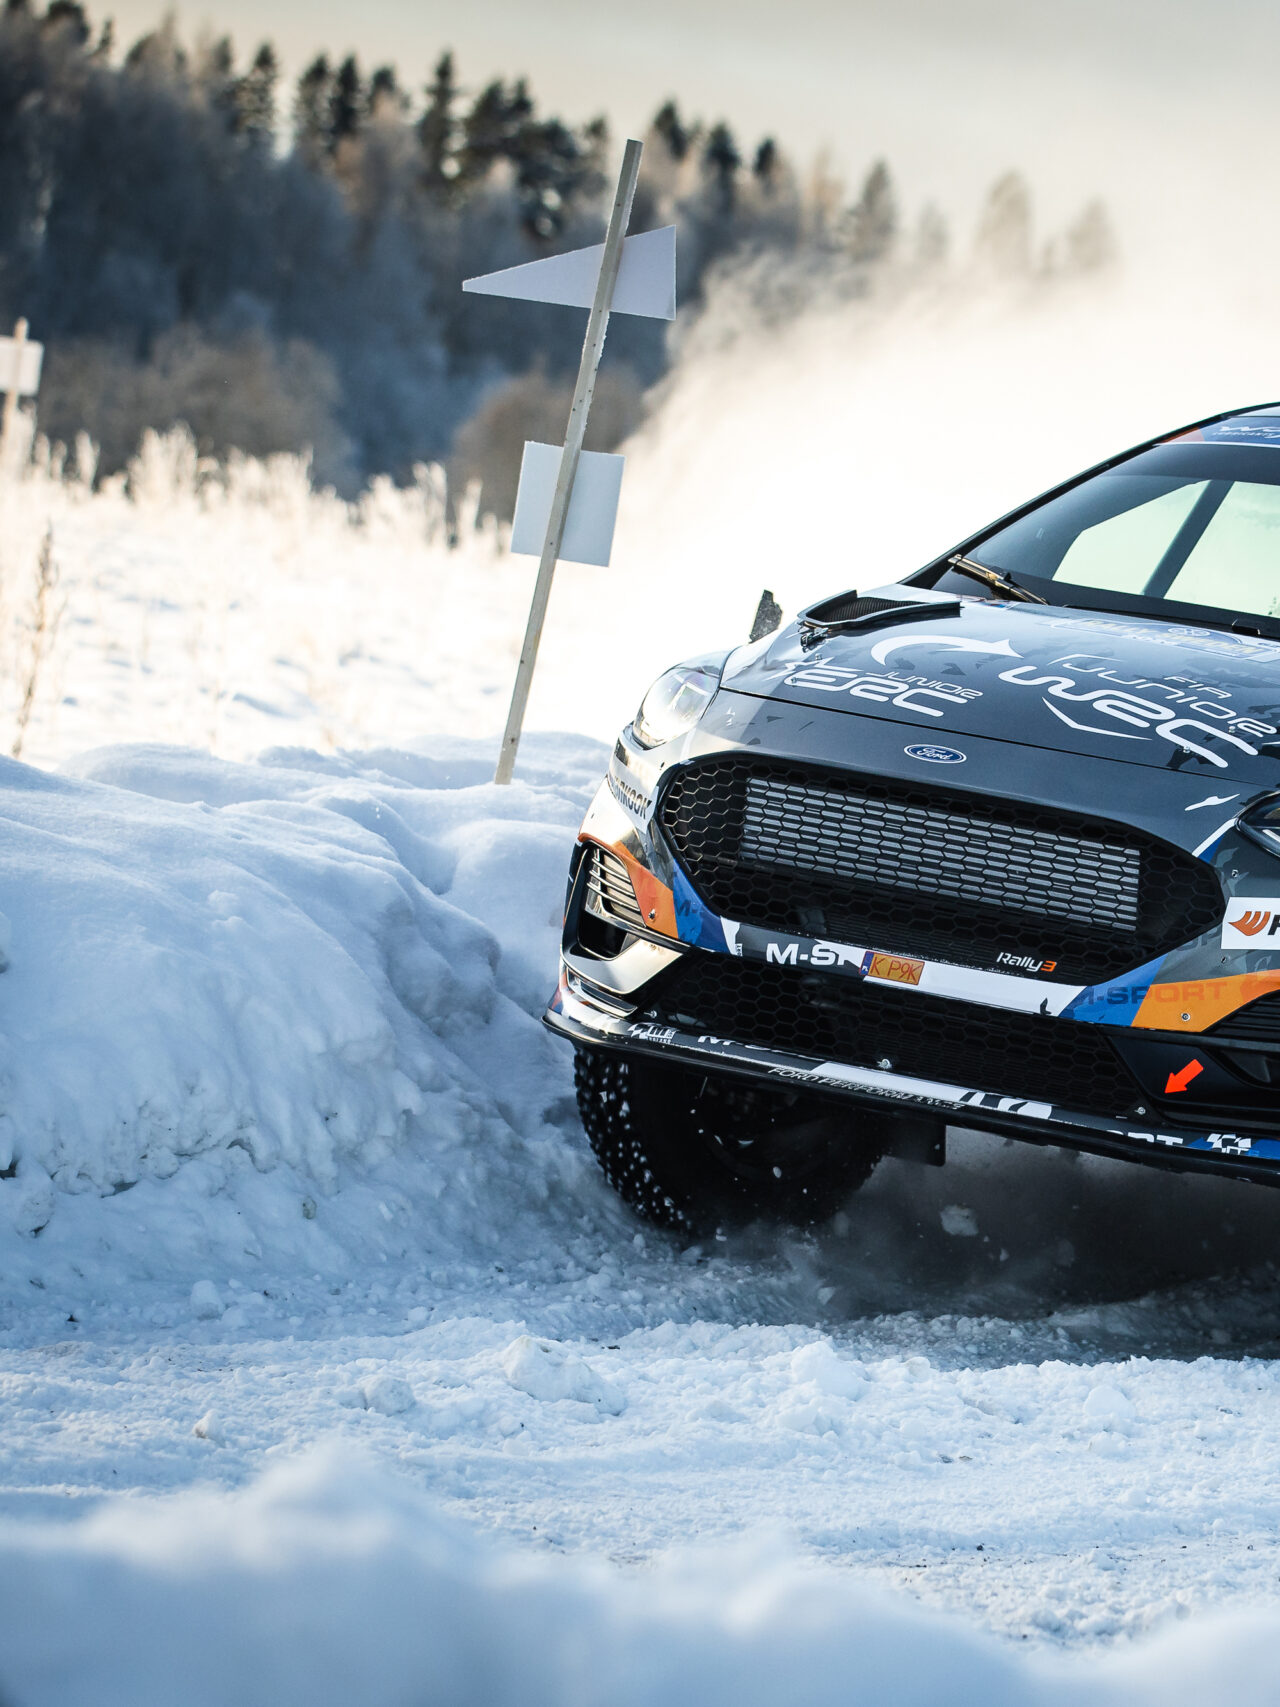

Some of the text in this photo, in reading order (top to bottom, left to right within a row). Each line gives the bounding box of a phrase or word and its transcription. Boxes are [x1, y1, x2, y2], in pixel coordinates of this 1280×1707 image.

[866, 671, 984, 700] JUNIOR
[1164, 675, 1233, 699] FIA
[1062, 662, 1278, 739] JUNIOR
[916, 746, 953, 761] Ford
[996, 951, 1057, 974] Rally3
[768, 1066, 818, 1084] FORD
